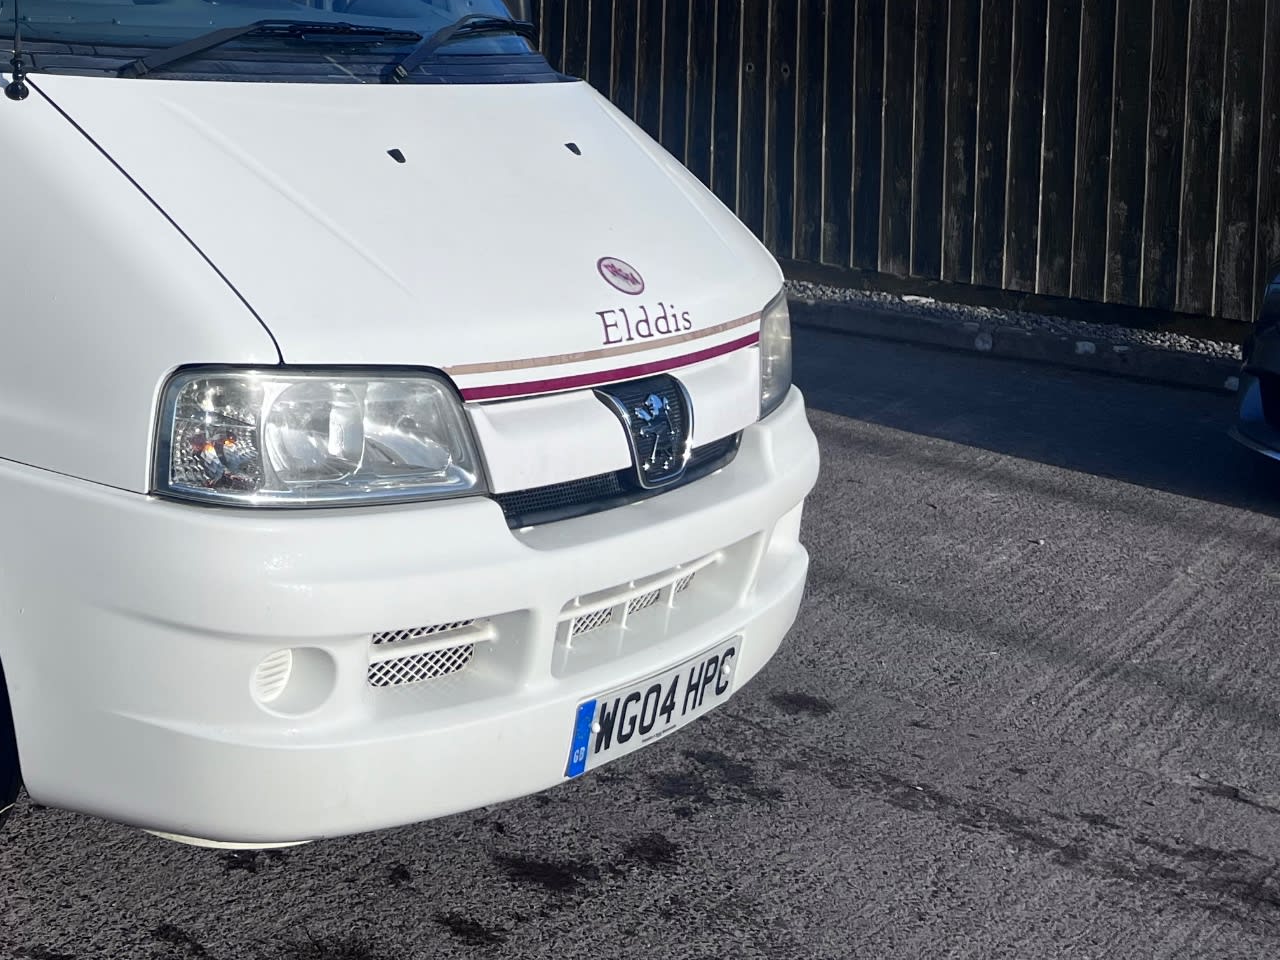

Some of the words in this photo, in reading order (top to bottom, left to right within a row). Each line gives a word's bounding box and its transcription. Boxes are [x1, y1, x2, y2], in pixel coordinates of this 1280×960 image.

[595, 301, 693, 345] Elddis
[594, 674, 680, 754] WG04
[681, 646, 736, 716] HPC
[573, 746, 586, 764] GB
